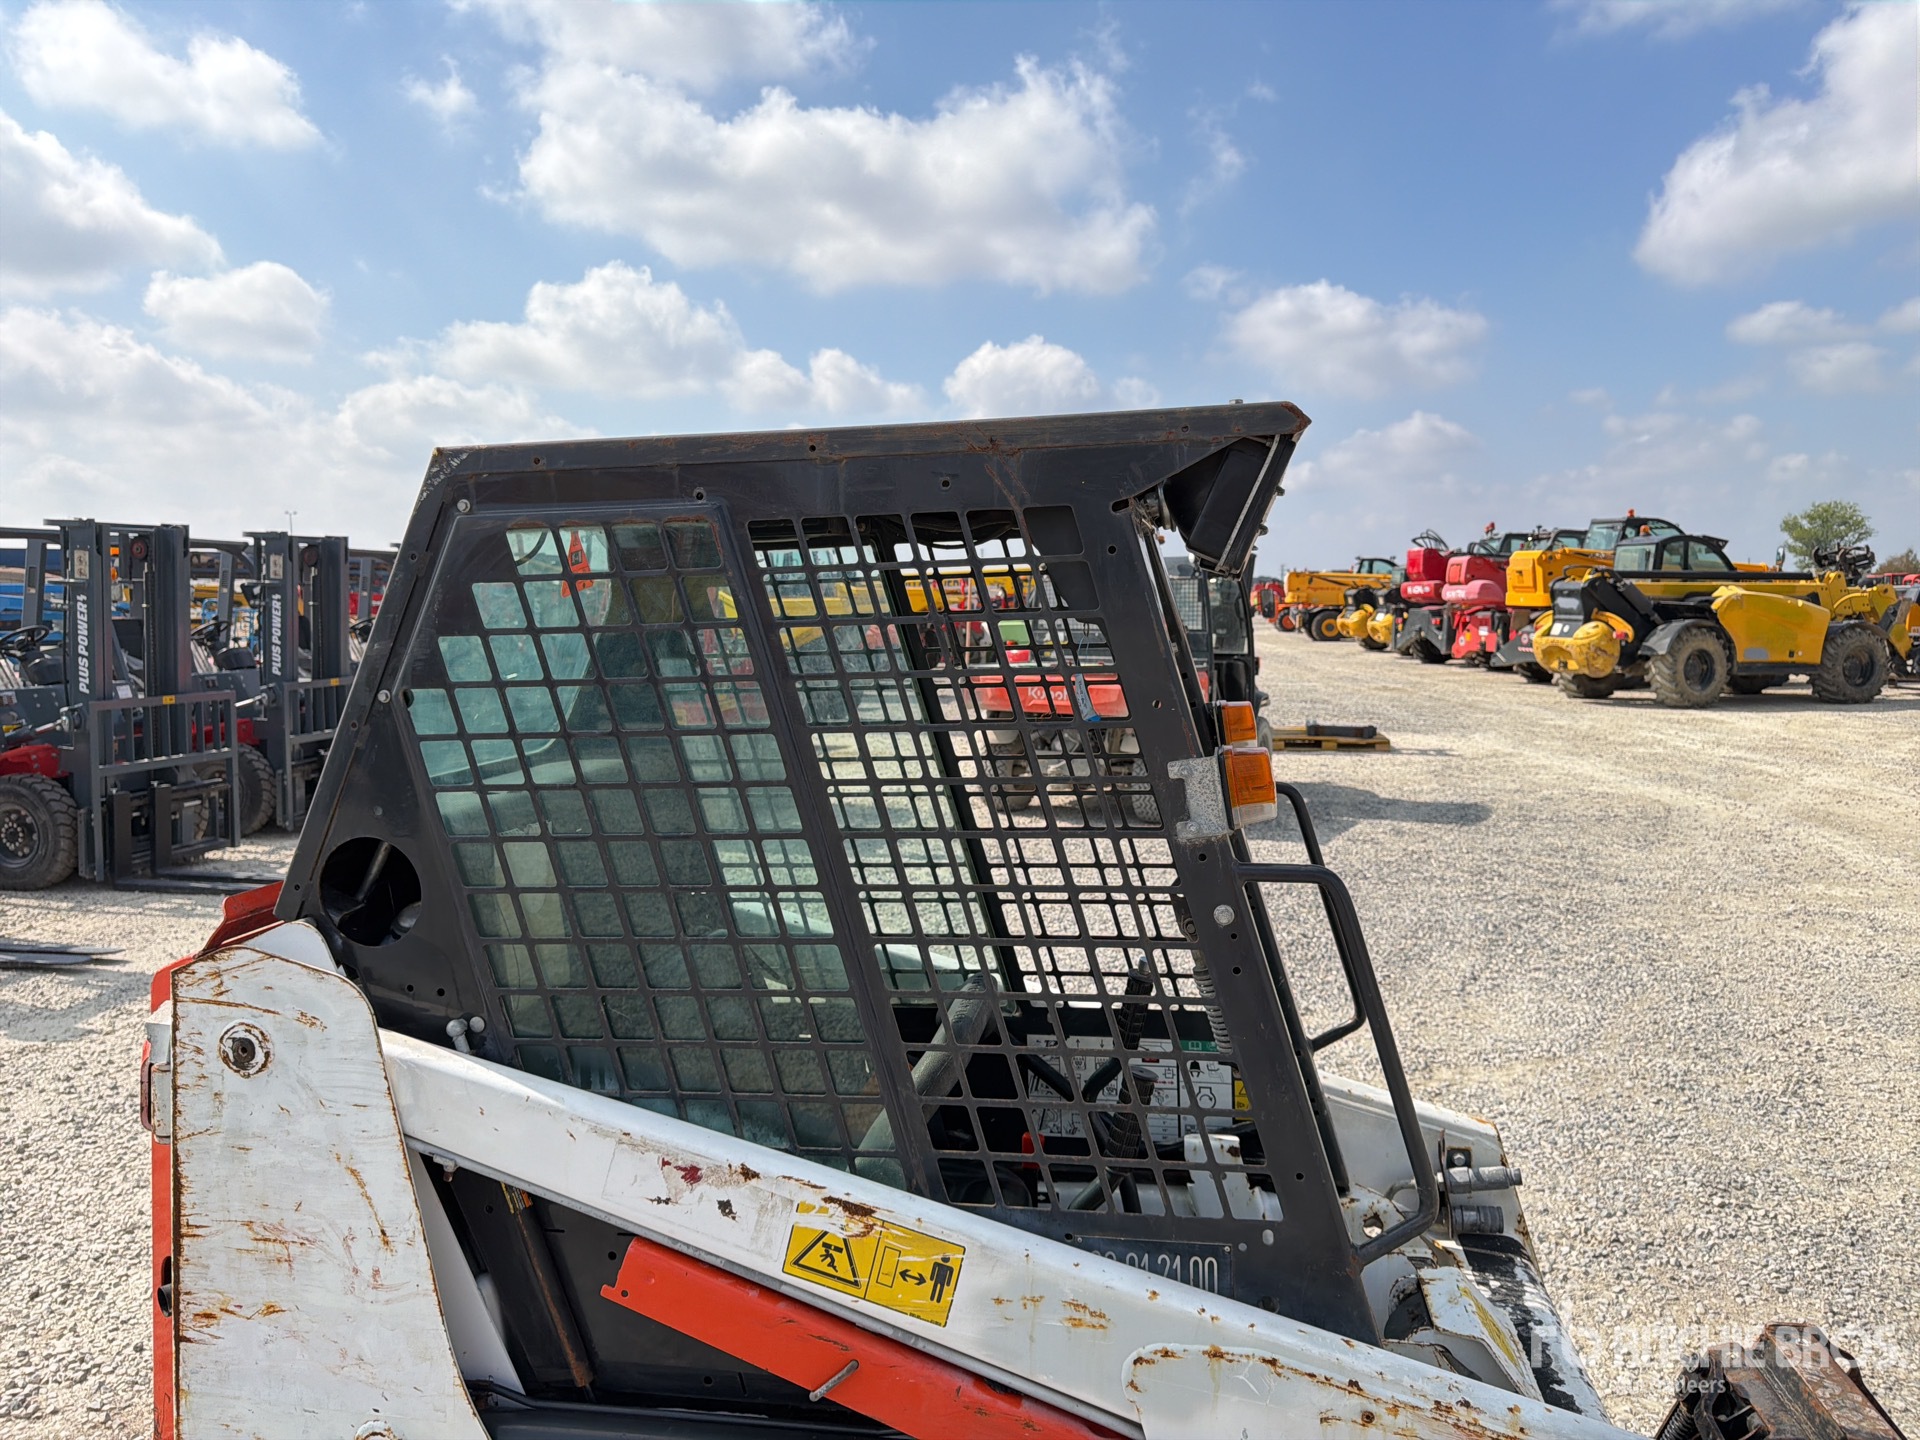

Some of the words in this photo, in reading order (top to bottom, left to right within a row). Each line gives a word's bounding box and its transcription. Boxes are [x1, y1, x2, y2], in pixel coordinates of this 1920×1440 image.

[77, 602, 89, 656] POWER
[272, 600, 281, 644] POWER
[79, 657, 90, 694] PLUS
[272, 644, 281, 676] PLUS
